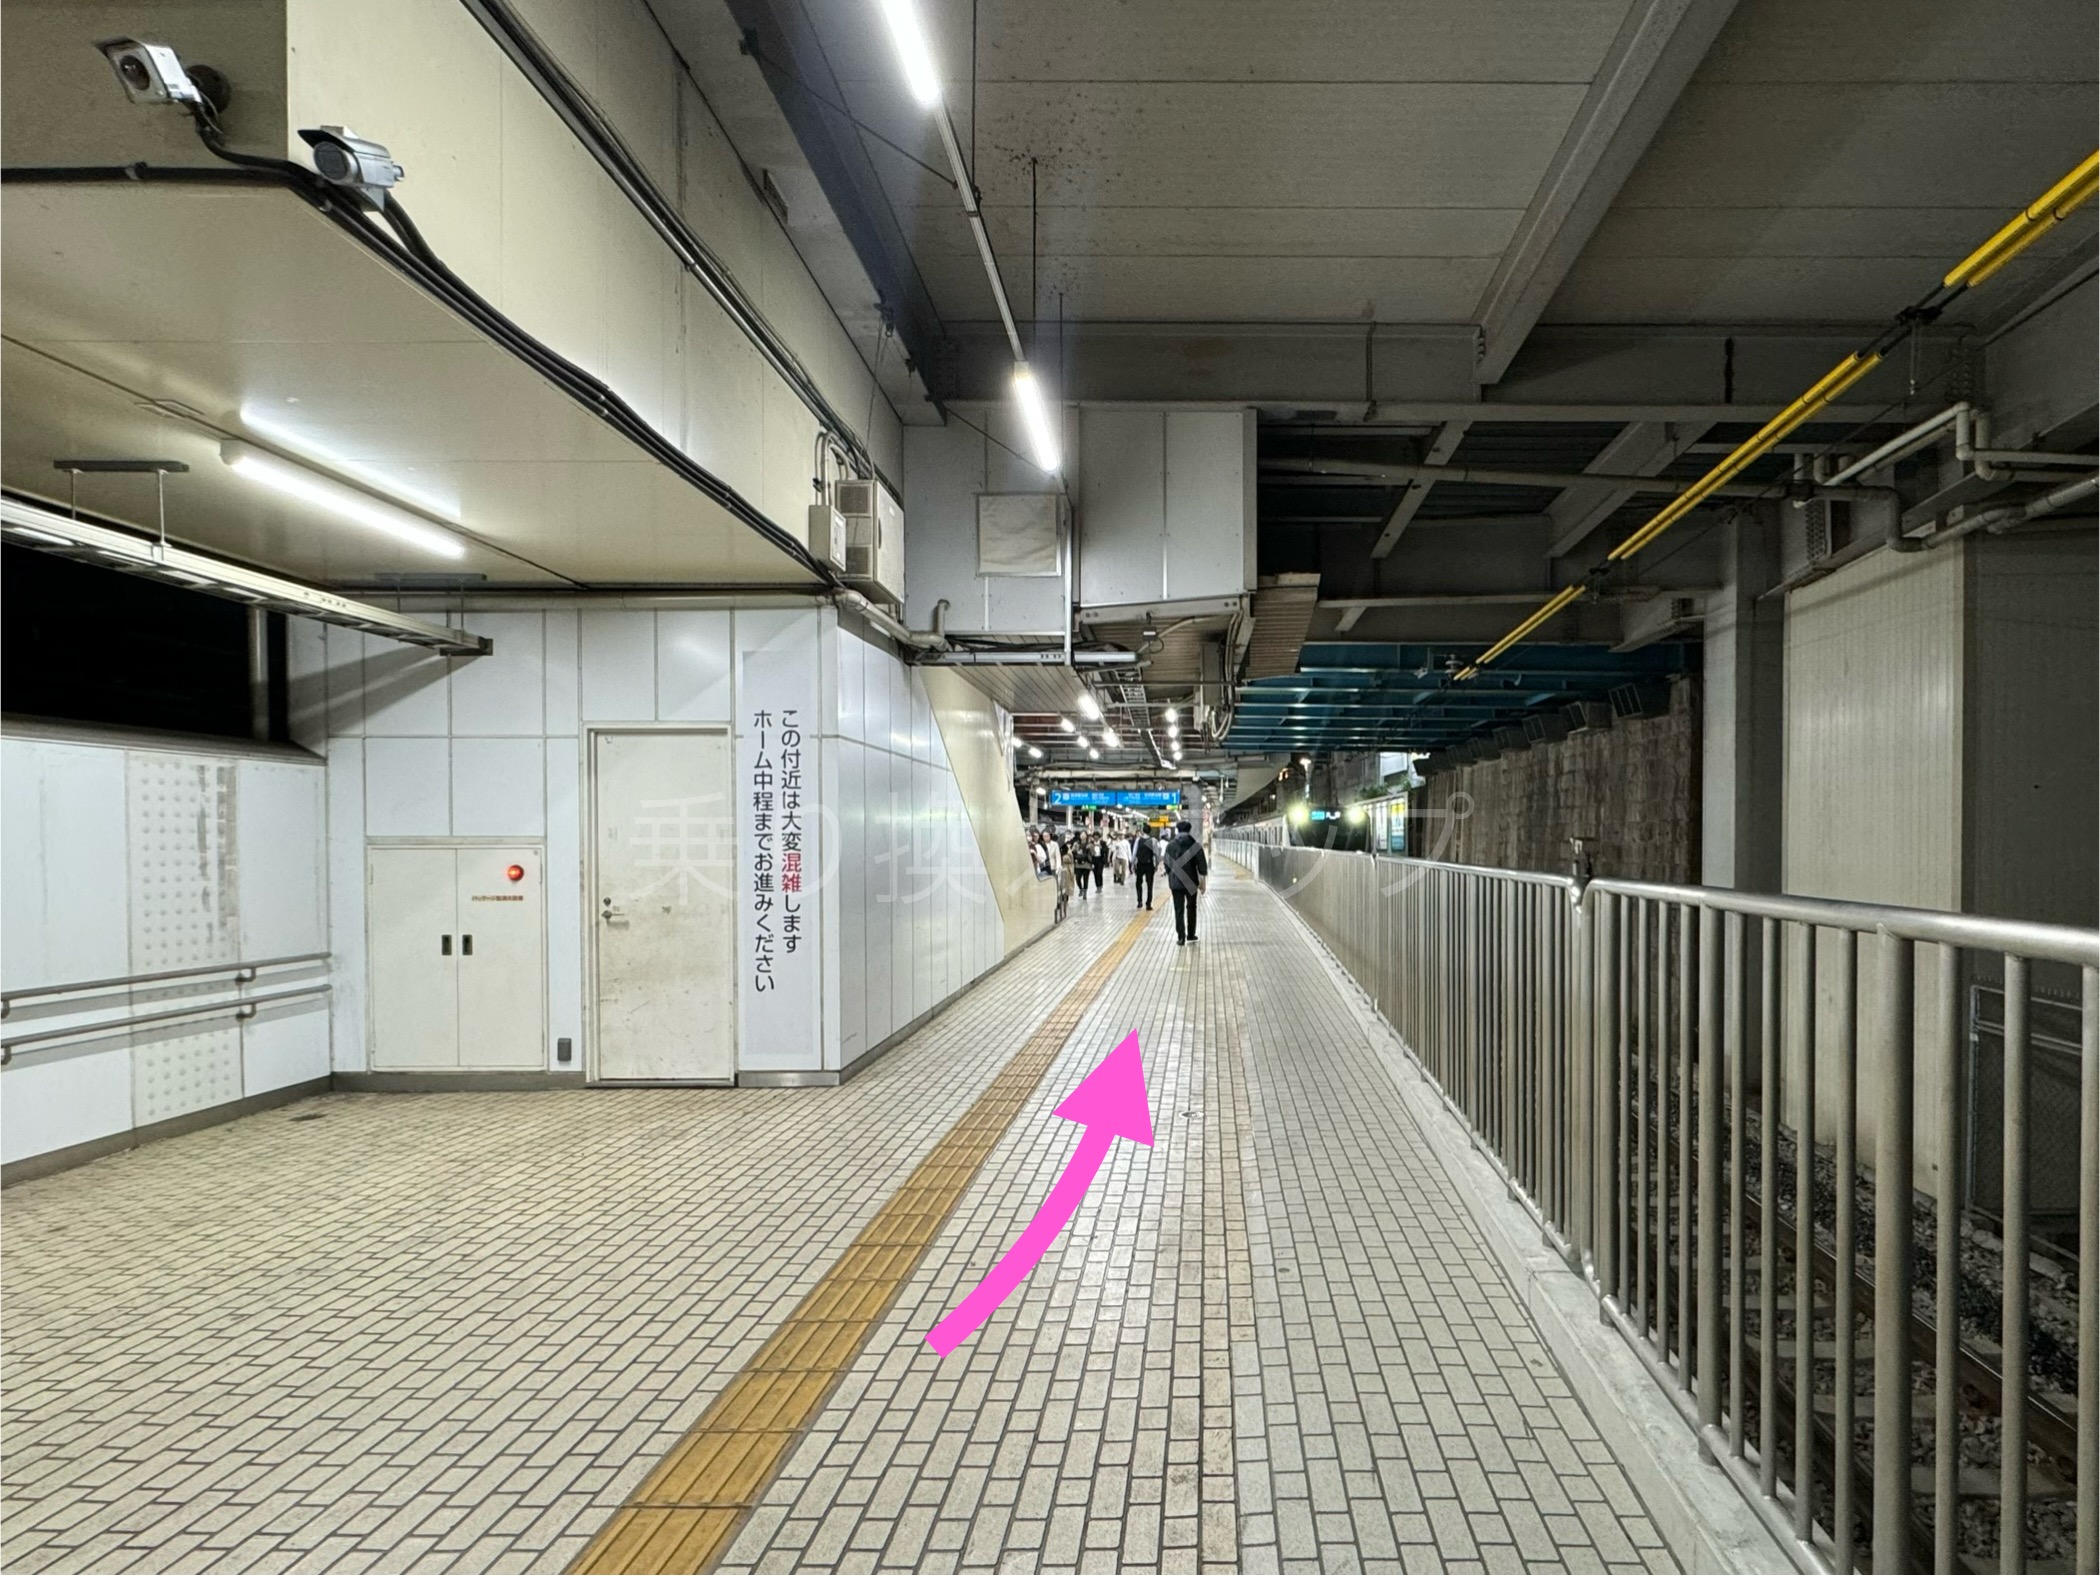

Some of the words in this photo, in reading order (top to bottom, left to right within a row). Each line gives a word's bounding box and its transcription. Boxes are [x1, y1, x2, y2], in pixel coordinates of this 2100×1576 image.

[752, 708, 775, 992] ホーム中程までお進みください
[780, 709, 803, 954] この付近は大変混雑します
[1054, 793, 1062, 804] 2
